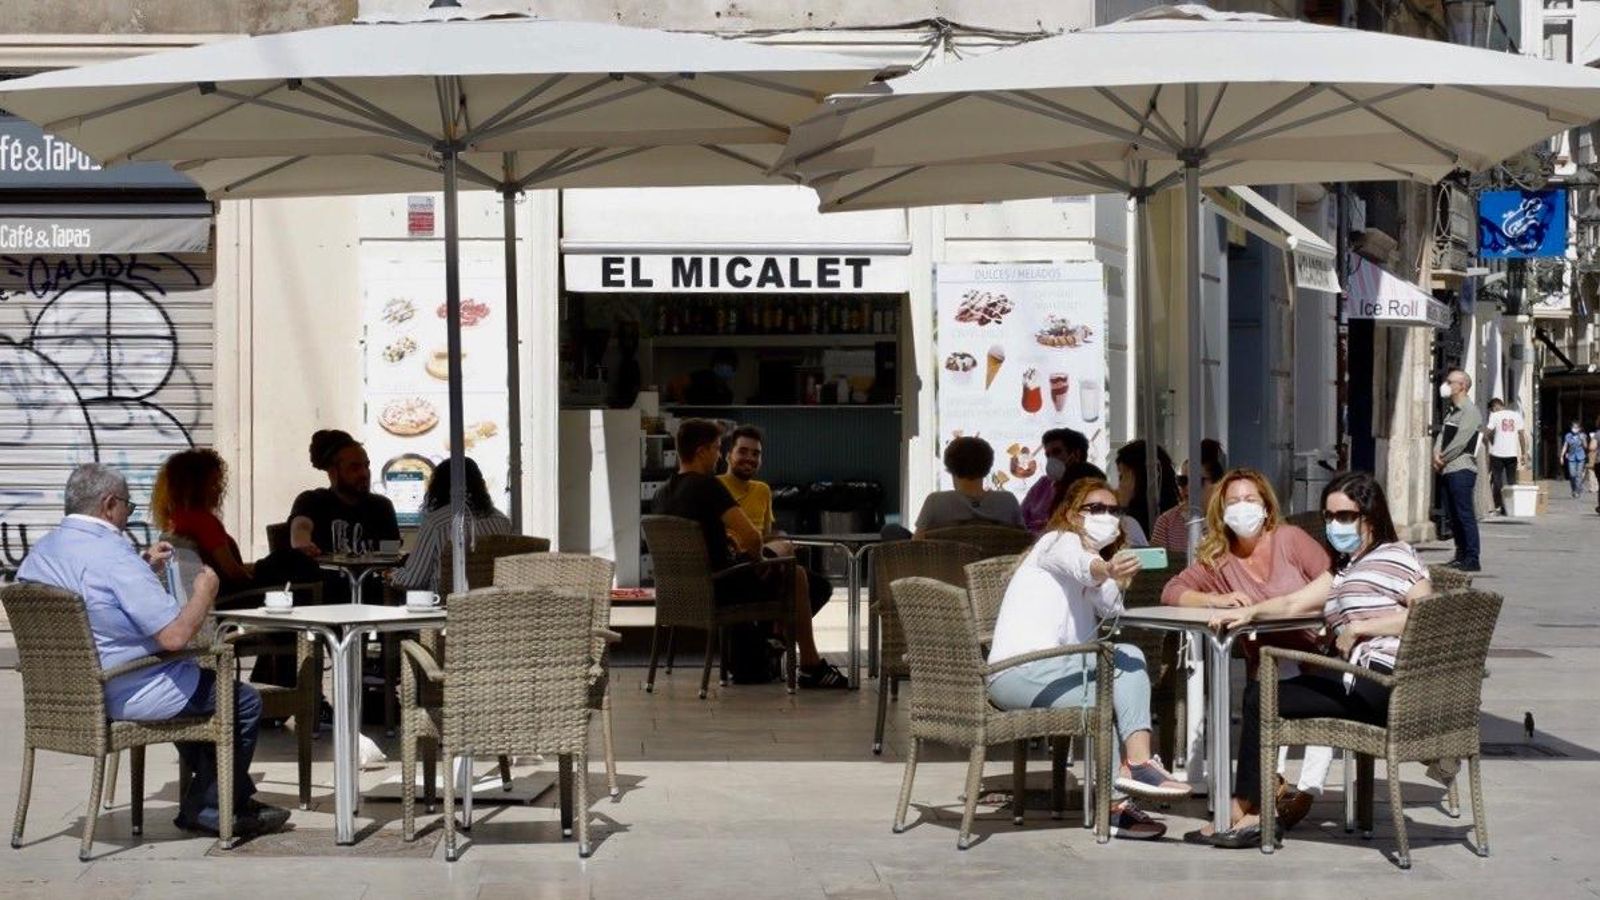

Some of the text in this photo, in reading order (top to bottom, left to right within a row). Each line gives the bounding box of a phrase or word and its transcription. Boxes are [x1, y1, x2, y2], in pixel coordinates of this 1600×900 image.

[601, 256, 871, 288] EL MICALET
[1360, 299, 1383, 316] Ice
[1388, 299, 1419, 316] Roll
